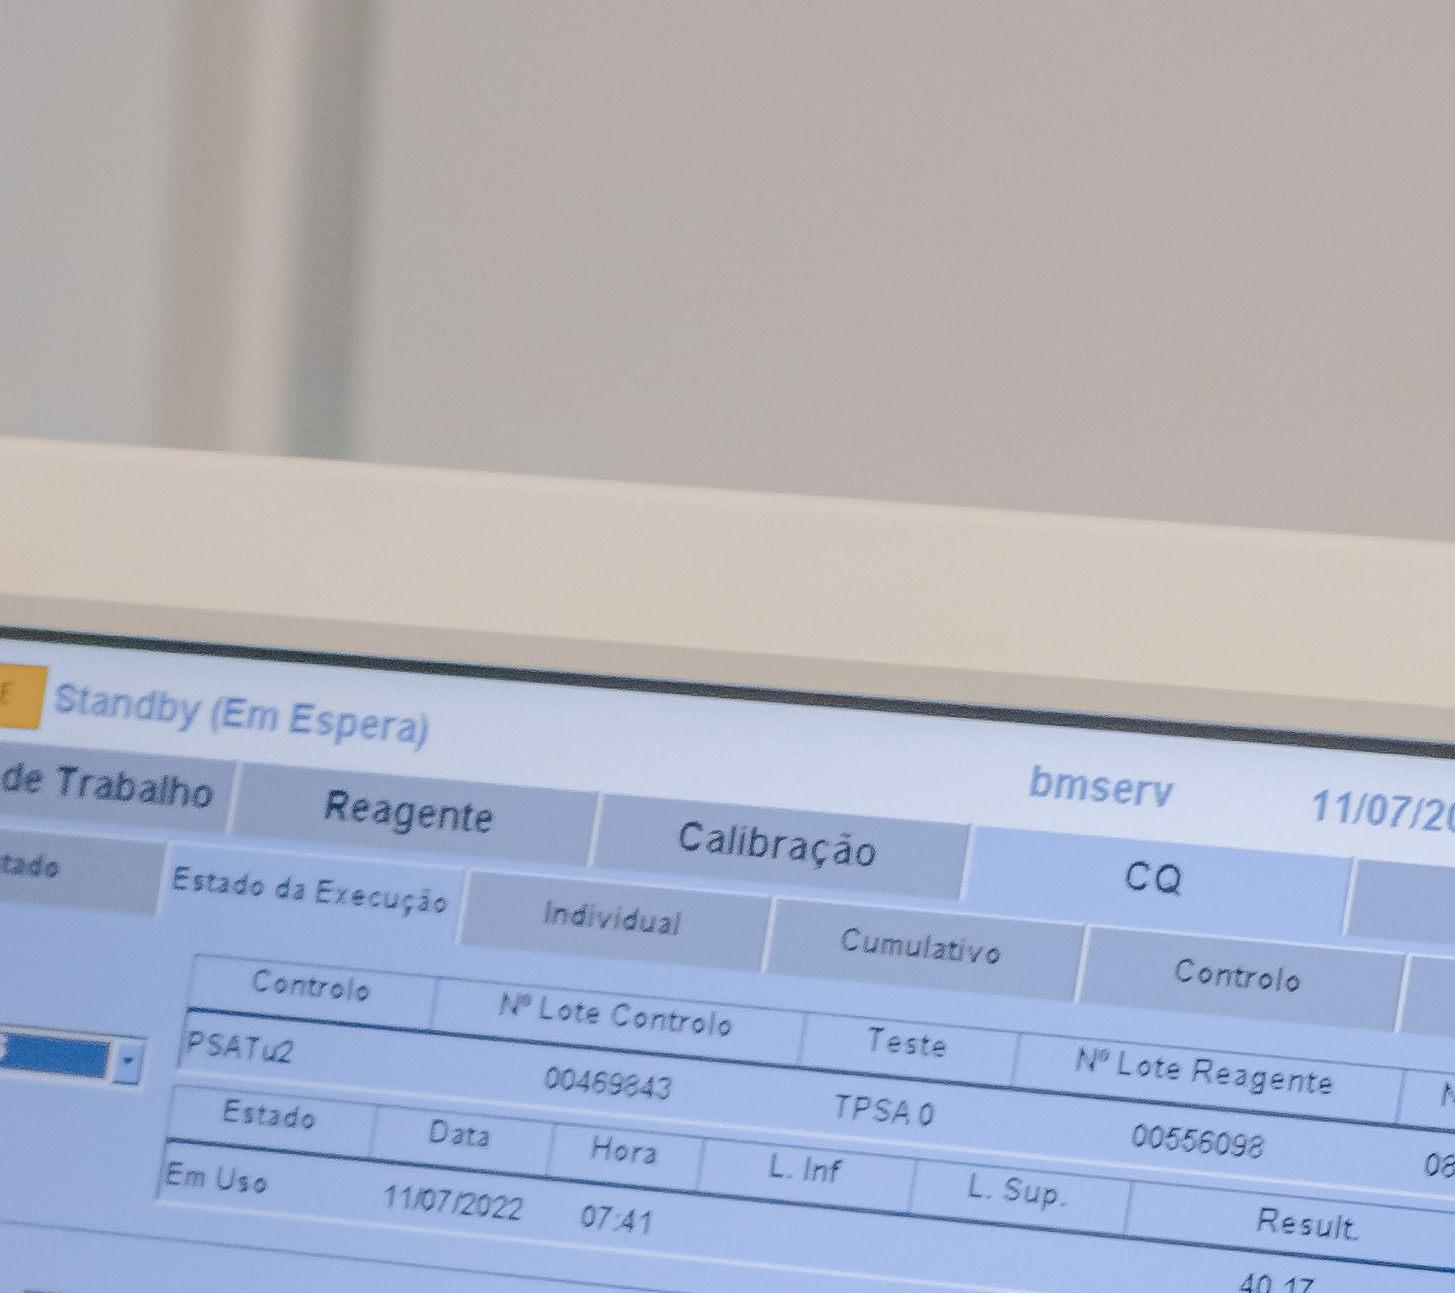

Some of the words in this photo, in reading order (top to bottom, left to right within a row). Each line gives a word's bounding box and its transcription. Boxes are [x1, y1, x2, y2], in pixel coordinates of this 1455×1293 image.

[54, 683, 199, 733] Standby
[208, 692, 278, 733] (Em
[290, 702, 432, 753] Espera)
[1, 760, 44, 794] de
[55, 763, 215, 811] Trabalho
[1029, 764, 1175, 808] bmserv
[323, 789, 495, 838] Reagente
[678, 818, 879, 870] Calibração
[172, 864, 265, 900] Estado
[273, 872, 307, 901] da
[313, 878, 451, 918] Execução
[1125, 859, 1183, 898] CQ
[543, 899, 683, 938] Individual
[840, 925, 1003, 967] Cumulativo
[250, 967, 372, 1004] Controlo
[1173, 957, 1303, 994] Controlo
[540, 995, 600, 1026] Lote
[611, 1000, 734, 1038] Controlo
[186, 1030, 295, 1066] PSATu2
[868, 1026, 948, 1059] Teste
[543, 1064, 675, 1102] 00469843
[1116, 1049, 1182, 1082] Lote
[1192, 1057, 1336, 1096] Reagente
[221, 1097, 318, 1132] Estado
[835, 1093, 910, 1126] TPSA
[428, 1117, 492, 1150] Data
[590, 1133, 659, 1166] Hora
[1131, 1122, 1266, 1160] 00556098
[165, 1160, 207, 1190] Em
[215, 1165, 268, 1196] Uso
[767, 1152, 795, 1180] L.
[802, 1155, 845, 1185] Inf
[383, 1182, 526, 1222] 11/07/2022
[968, 1173, 995, 1202] L.
[1003, 1177, 1069, 1210] Sup.
[579, 1202, 654, 1236] 07:41
[1256, 1206, 1360, 1243] Result.
